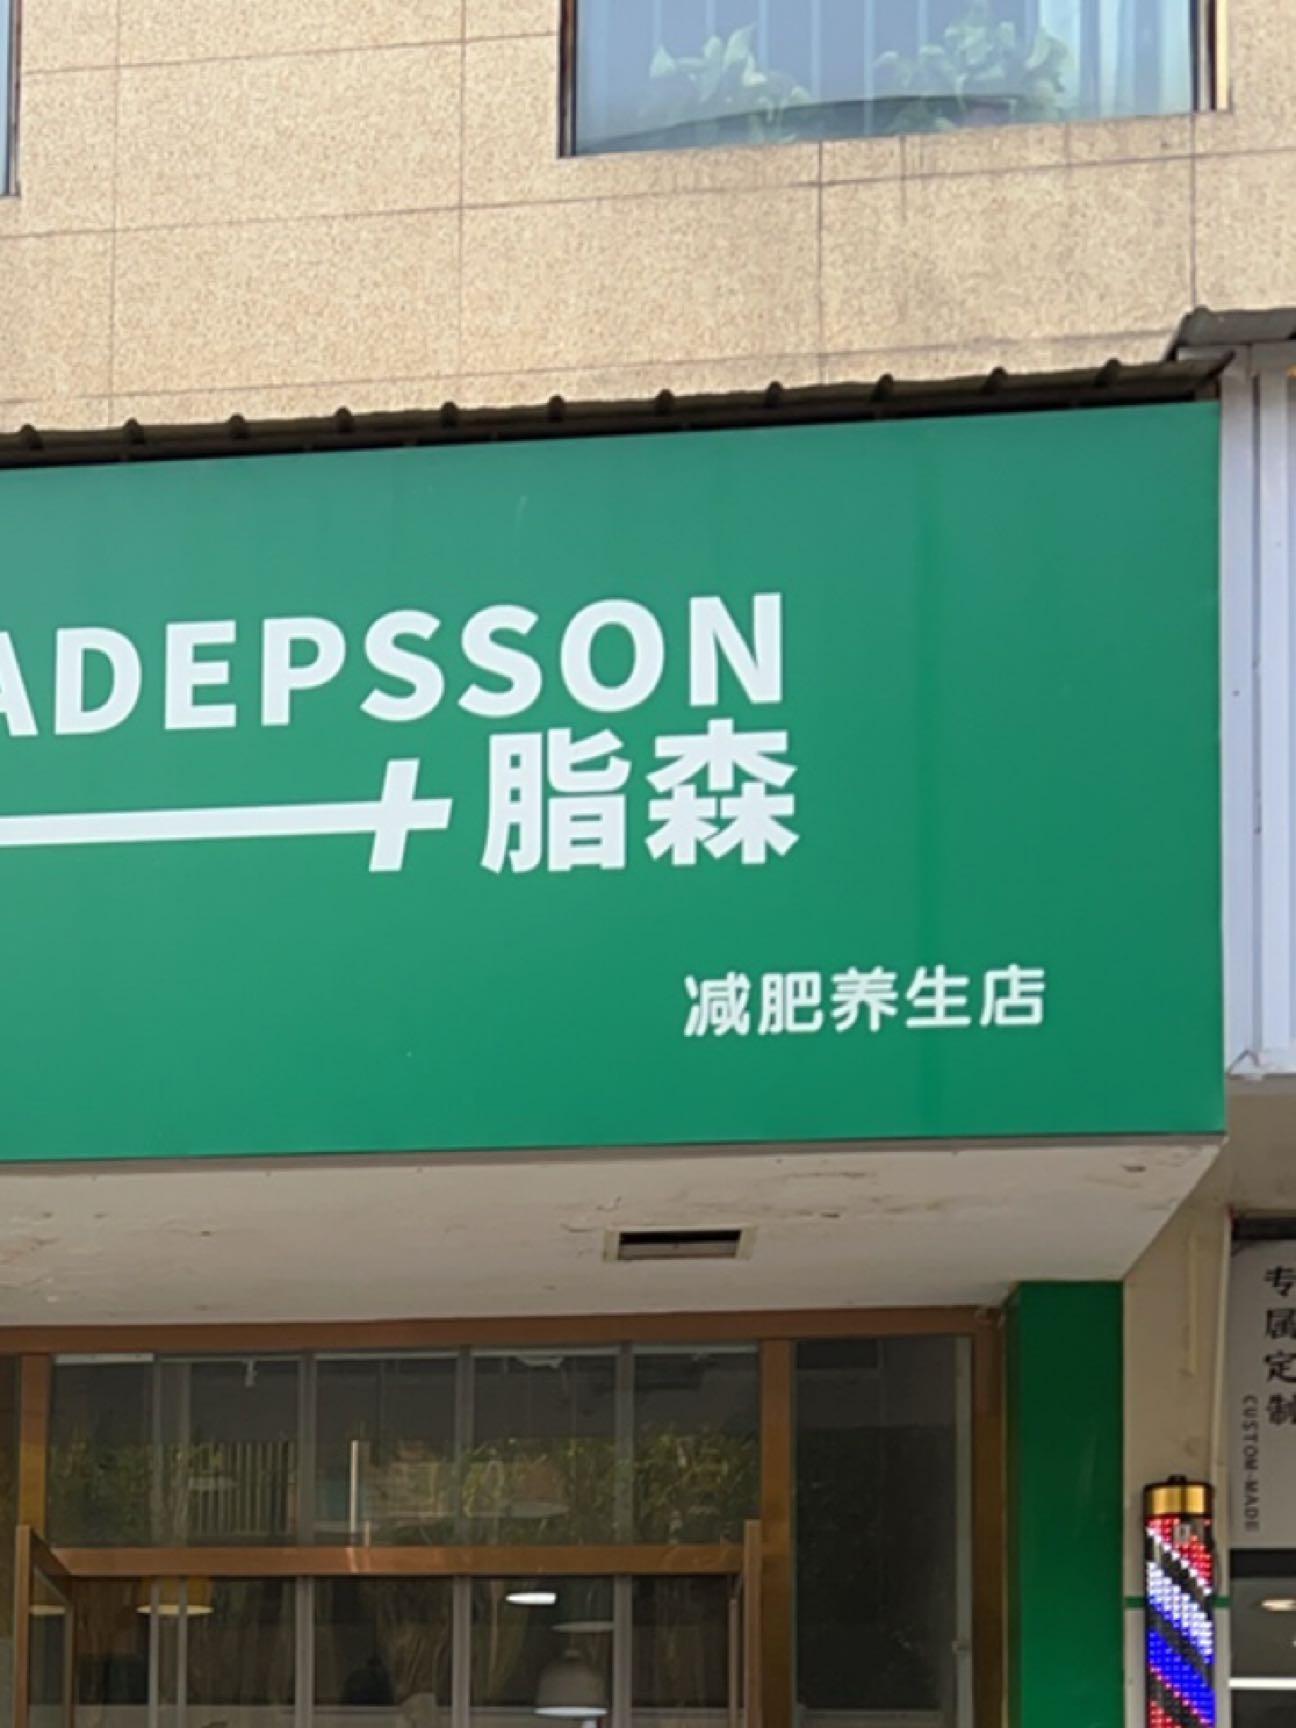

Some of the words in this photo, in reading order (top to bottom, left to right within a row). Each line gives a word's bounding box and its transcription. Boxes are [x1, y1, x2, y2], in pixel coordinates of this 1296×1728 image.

[481, 718, 800, 875] 脂森
[683, 964, 1047, 1038] 减肥养生店
